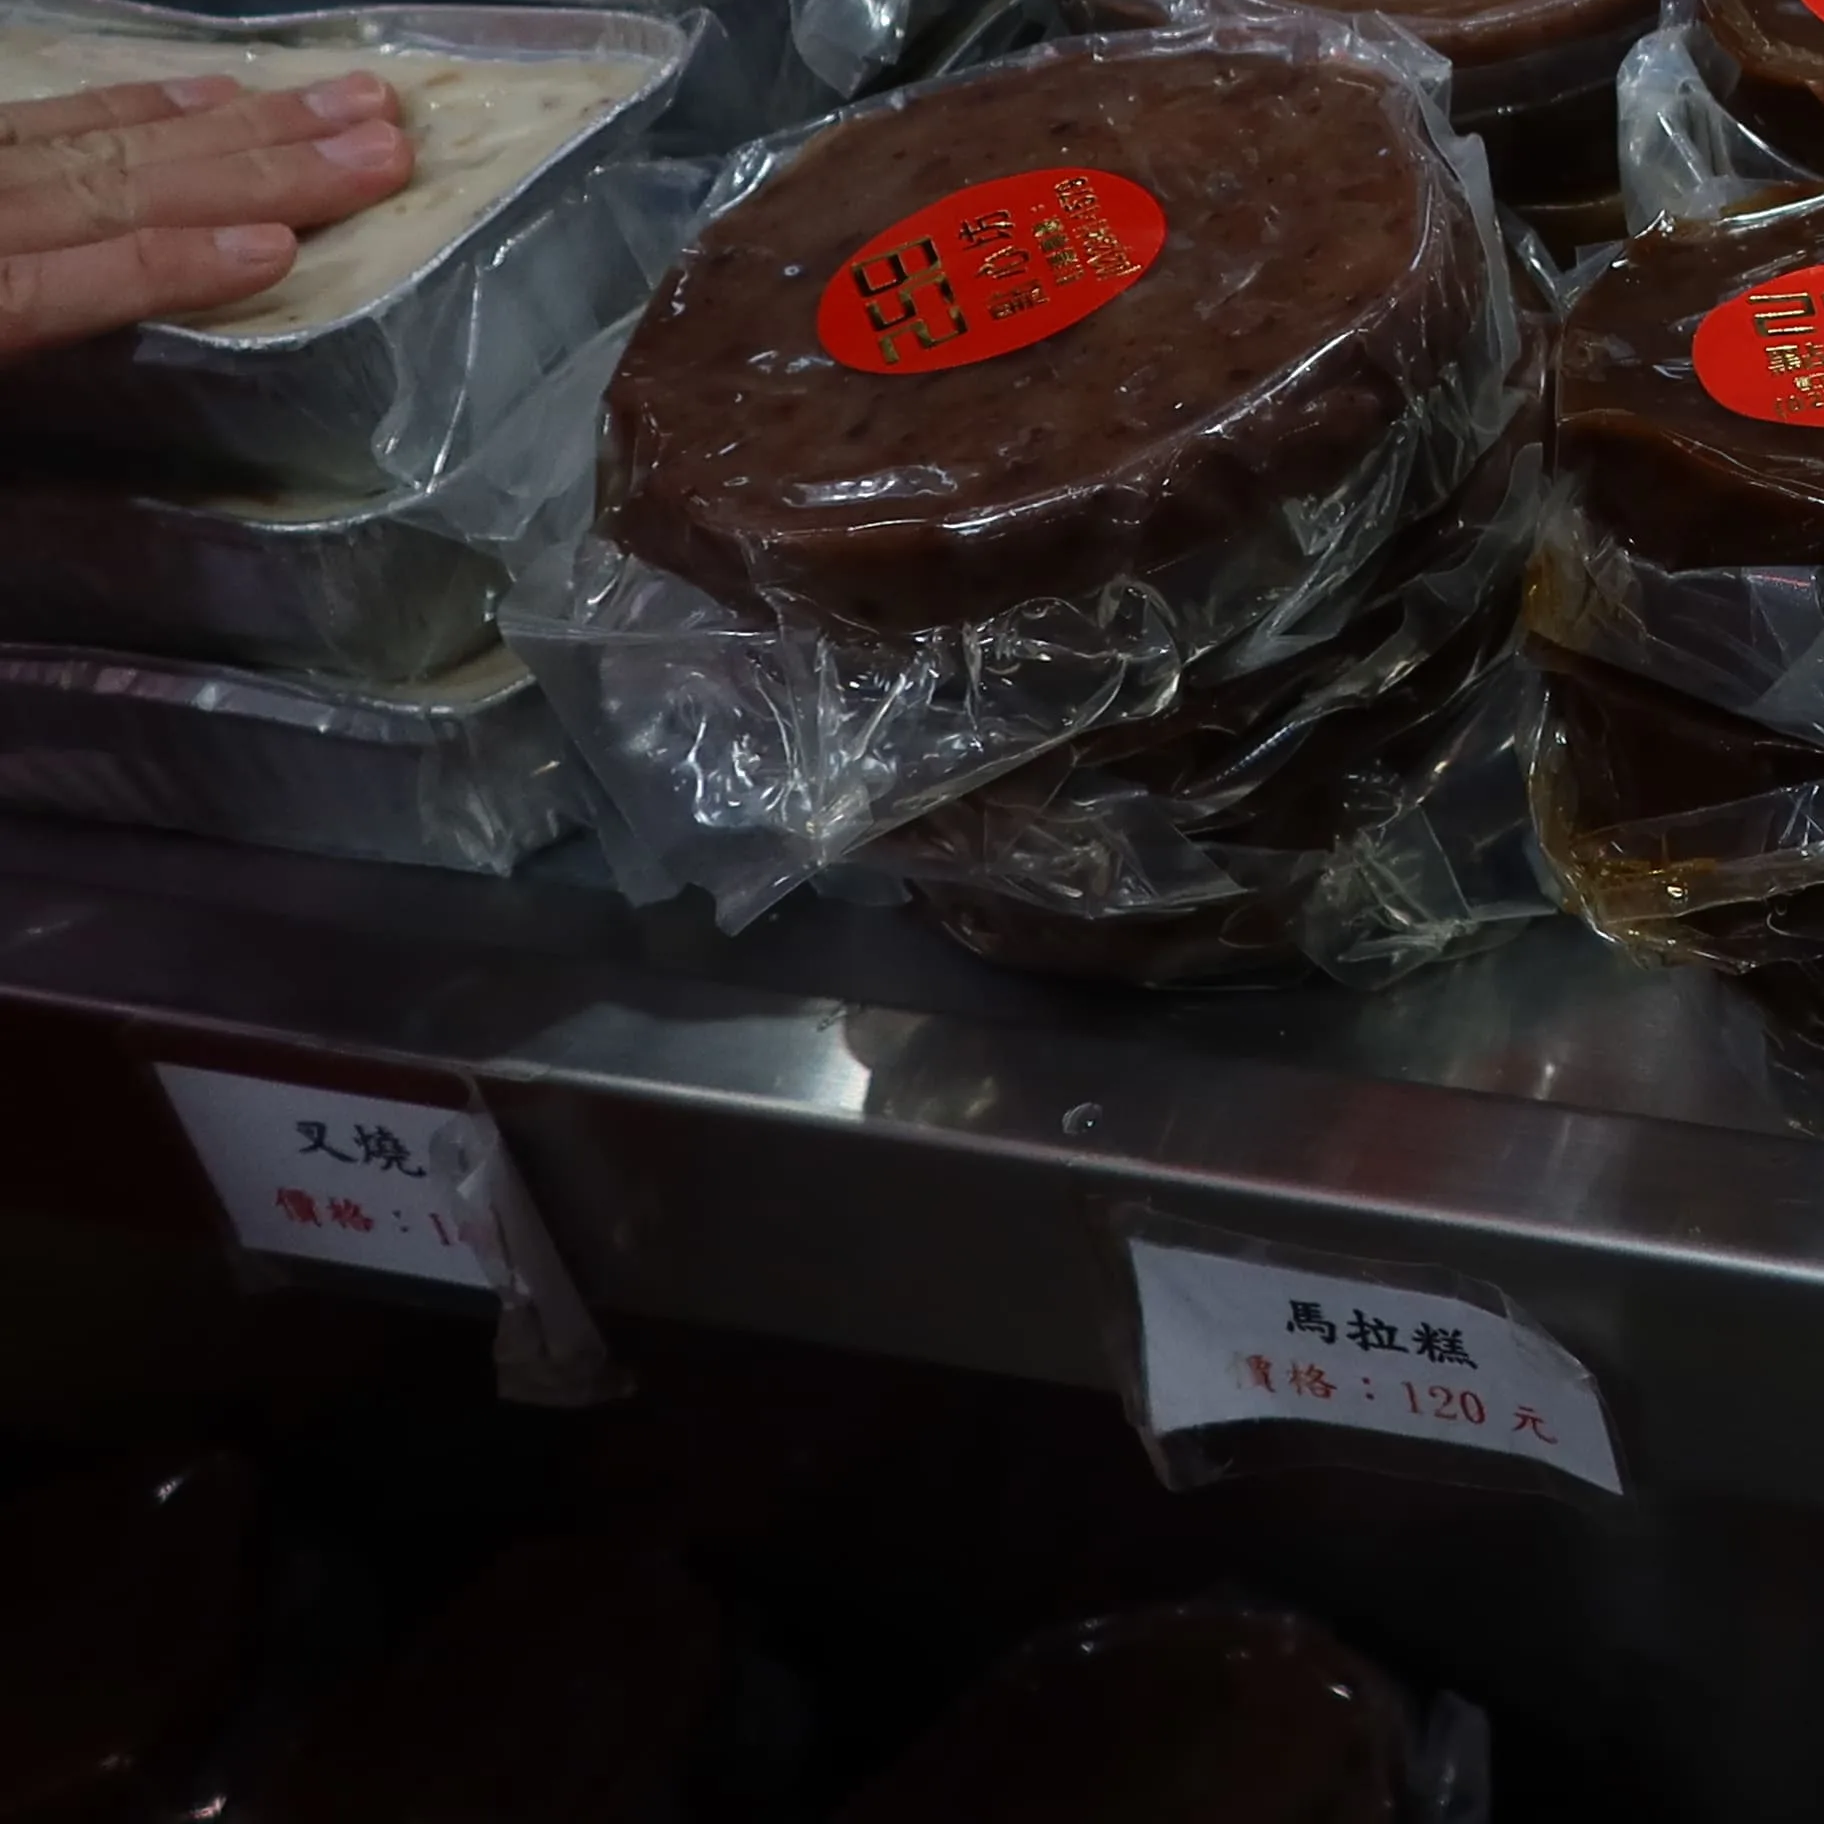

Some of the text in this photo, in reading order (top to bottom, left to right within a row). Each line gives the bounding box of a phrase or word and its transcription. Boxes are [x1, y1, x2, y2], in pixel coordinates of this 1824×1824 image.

[852, 235, 968, 364] 258
[296, 1121, 440, 1179] 叉燒
[1287, 1300, 1478, 1370] 馬拉糕
